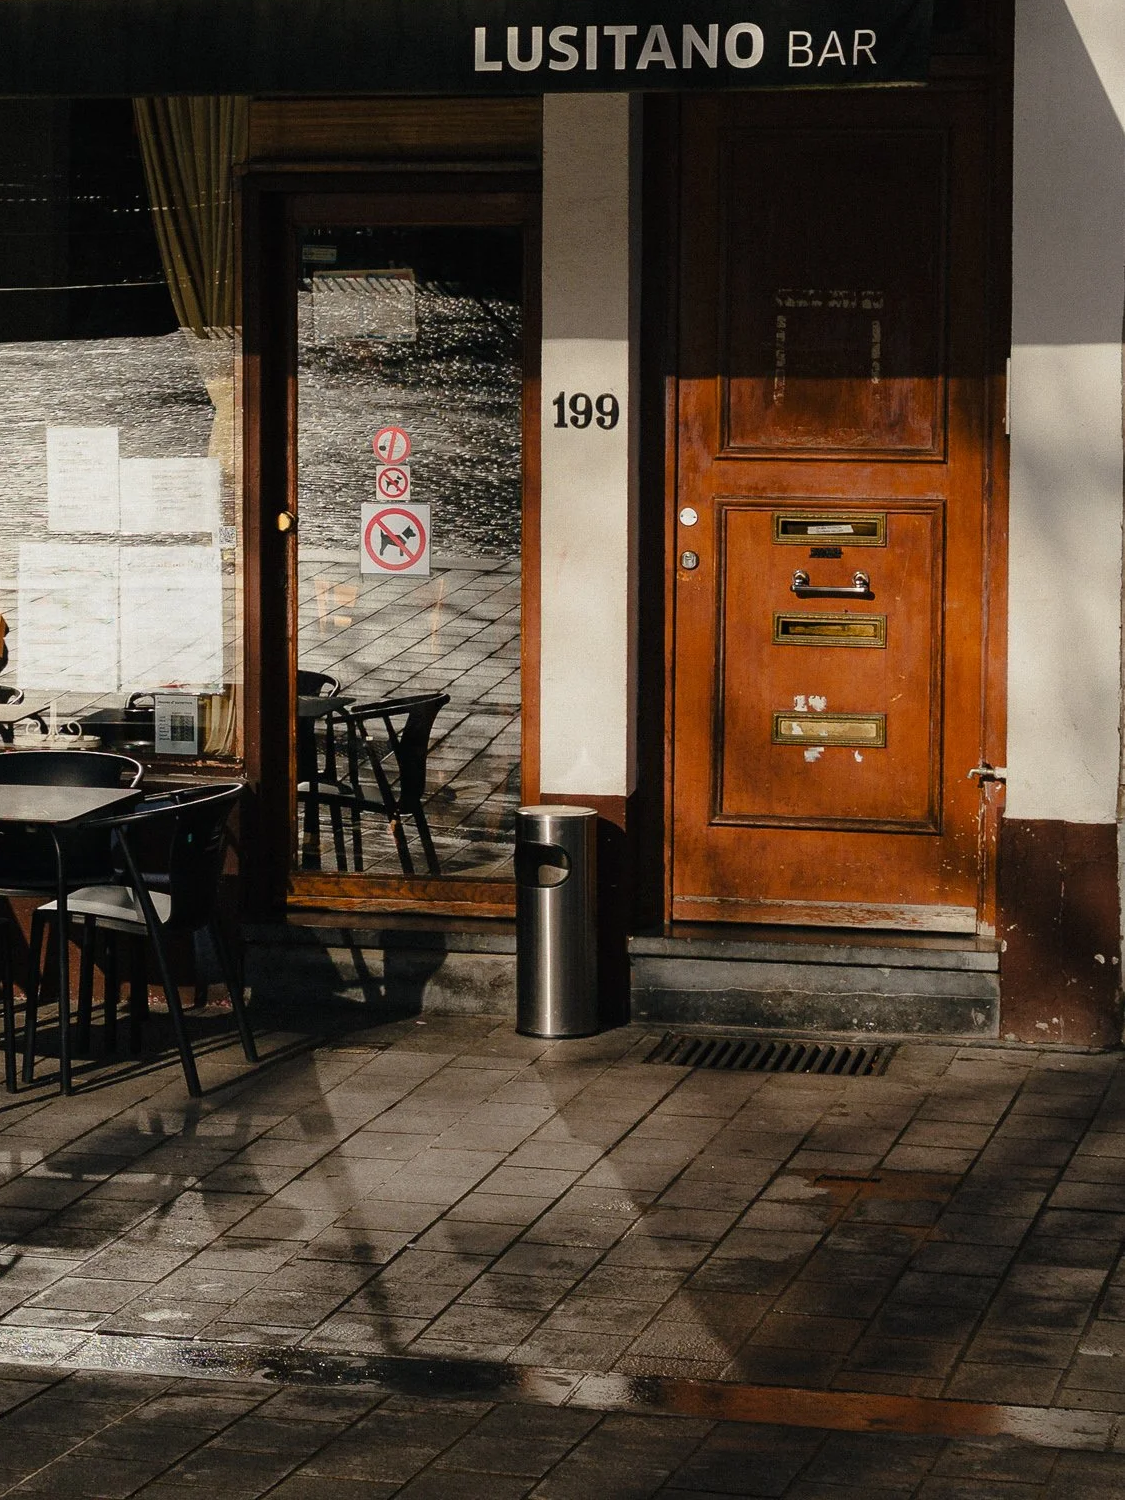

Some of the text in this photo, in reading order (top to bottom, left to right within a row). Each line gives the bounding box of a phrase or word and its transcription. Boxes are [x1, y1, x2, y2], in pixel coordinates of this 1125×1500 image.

[474, 22, 878, 72] LUSITANO BAR
[552, 391, 620, 431] 199
